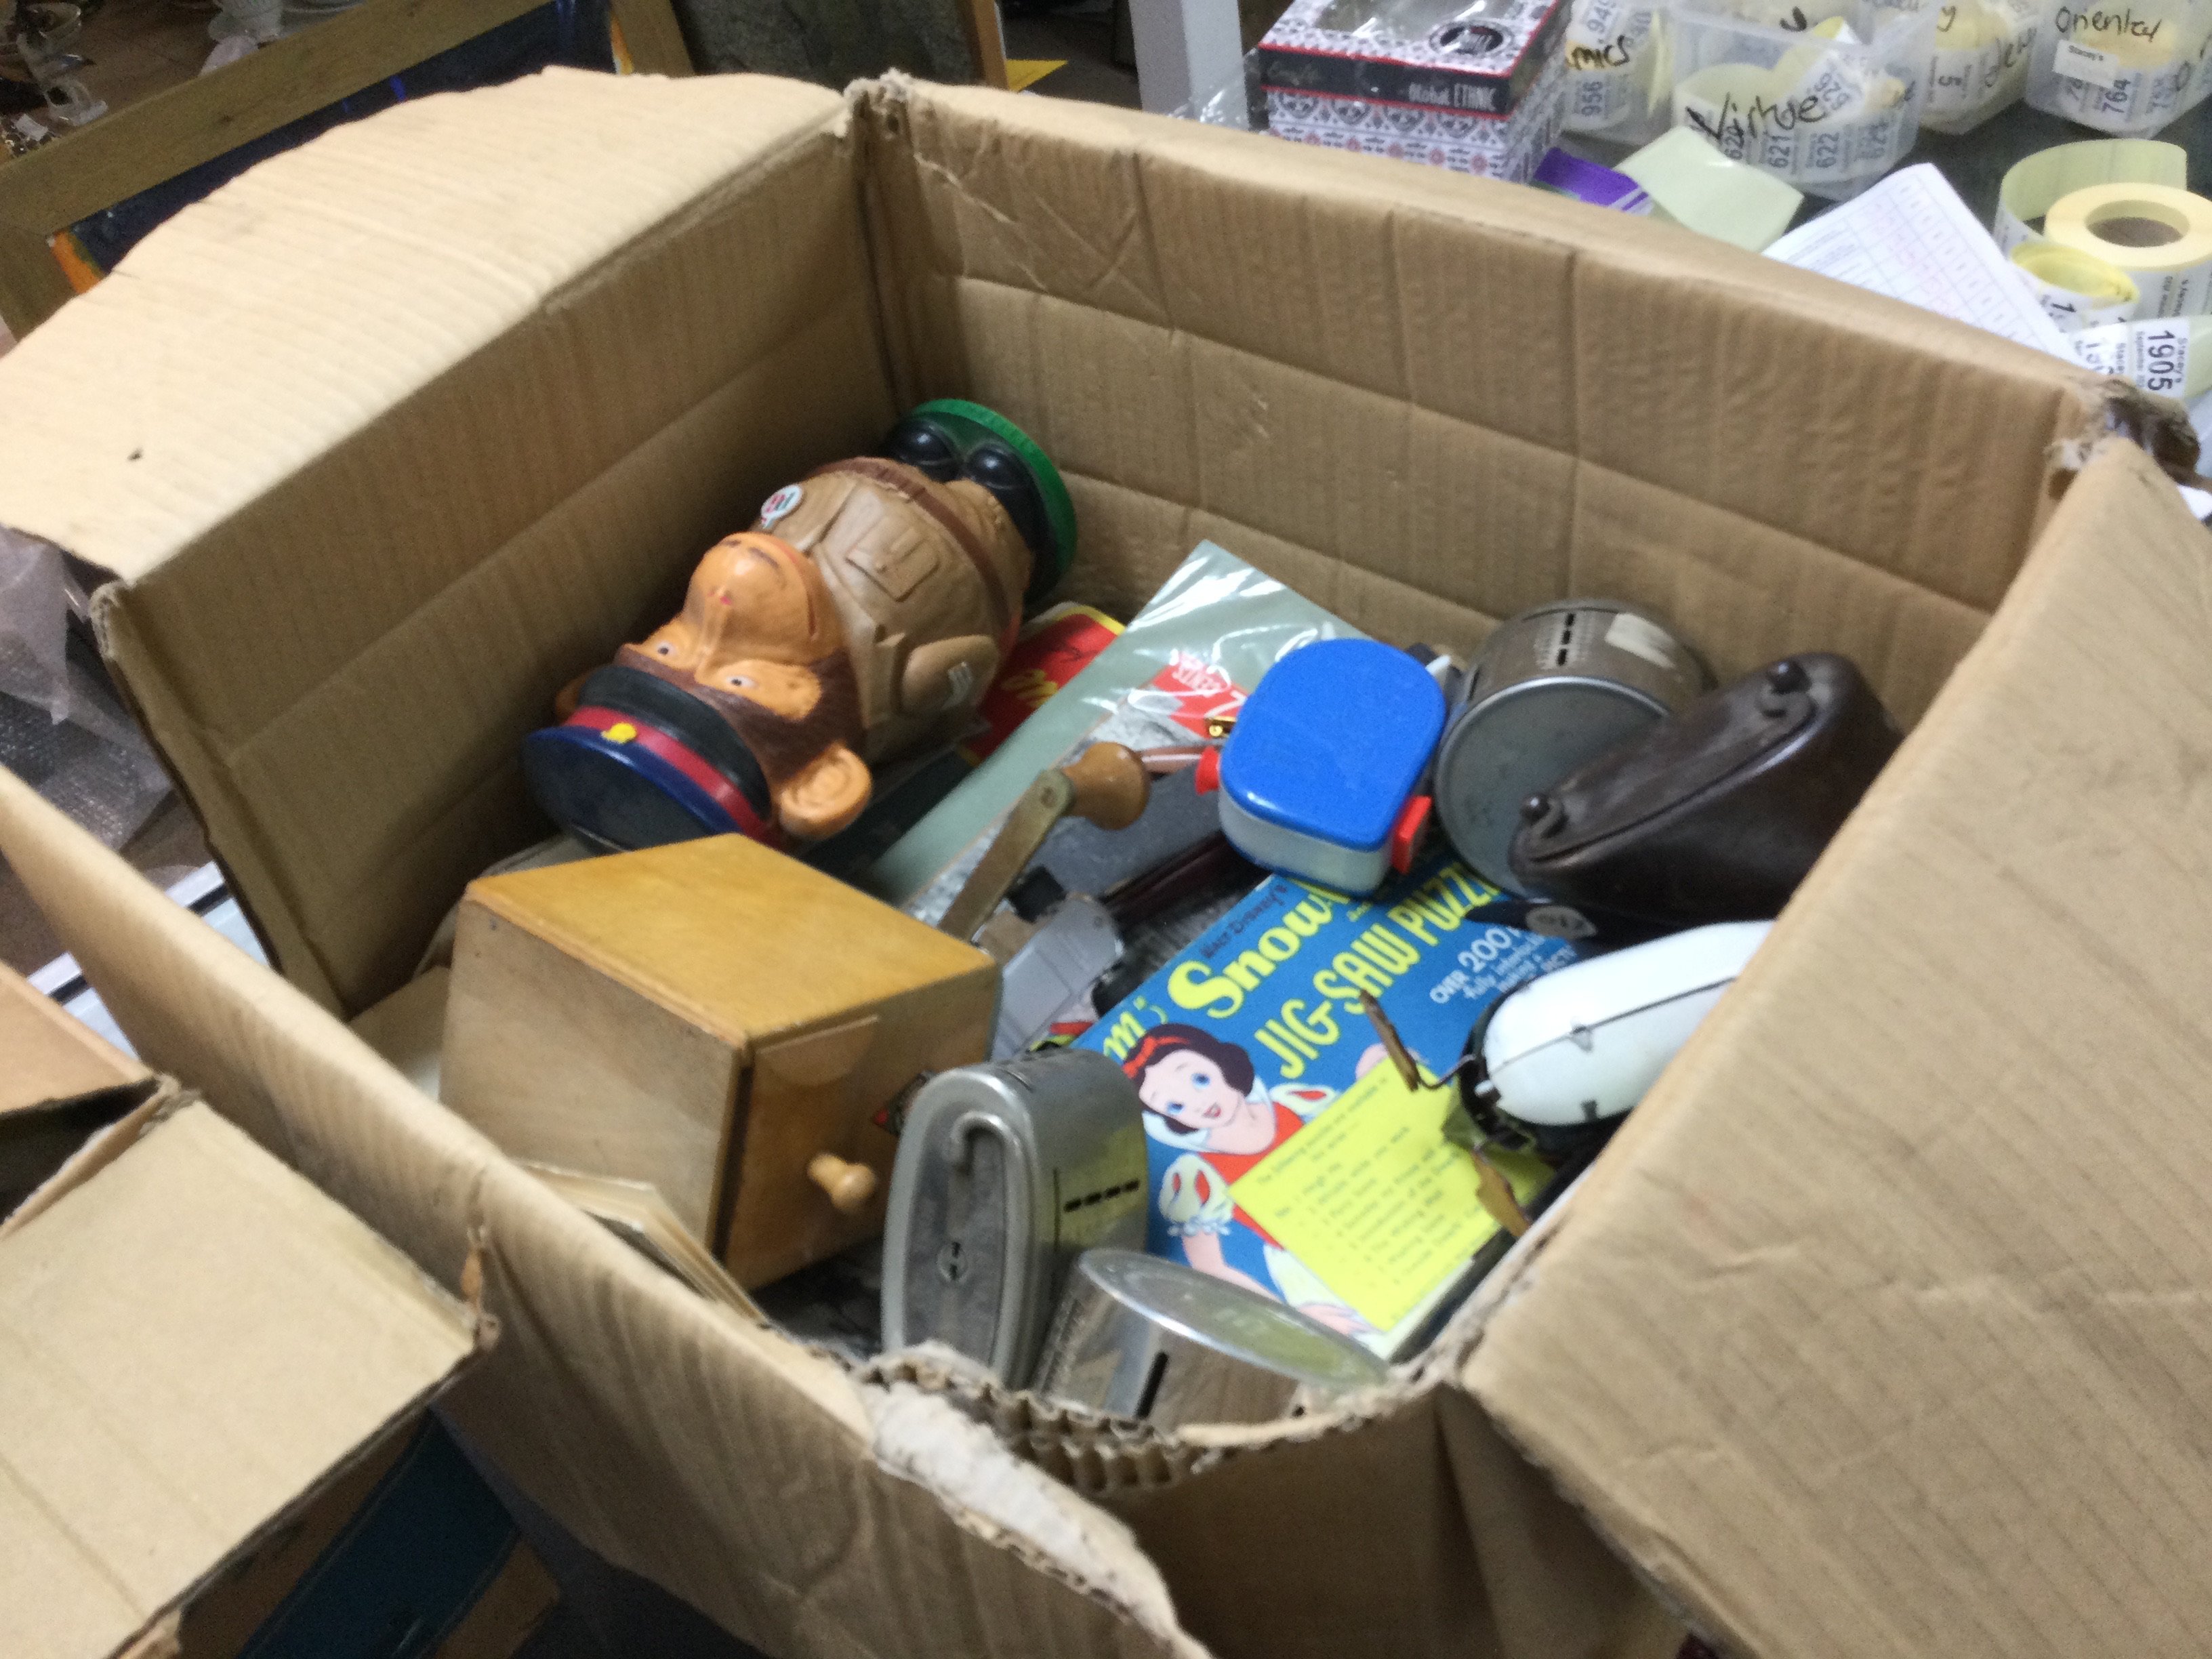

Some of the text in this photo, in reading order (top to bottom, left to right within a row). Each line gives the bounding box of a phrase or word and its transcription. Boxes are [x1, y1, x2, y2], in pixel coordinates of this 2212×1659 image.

[1767, 134, 1792, 169] 621
[2147, 329, 2175, 391] 1905
[1166, 893, 1333, 1019] Snow
[1457, 926, 1513, 973] 200
